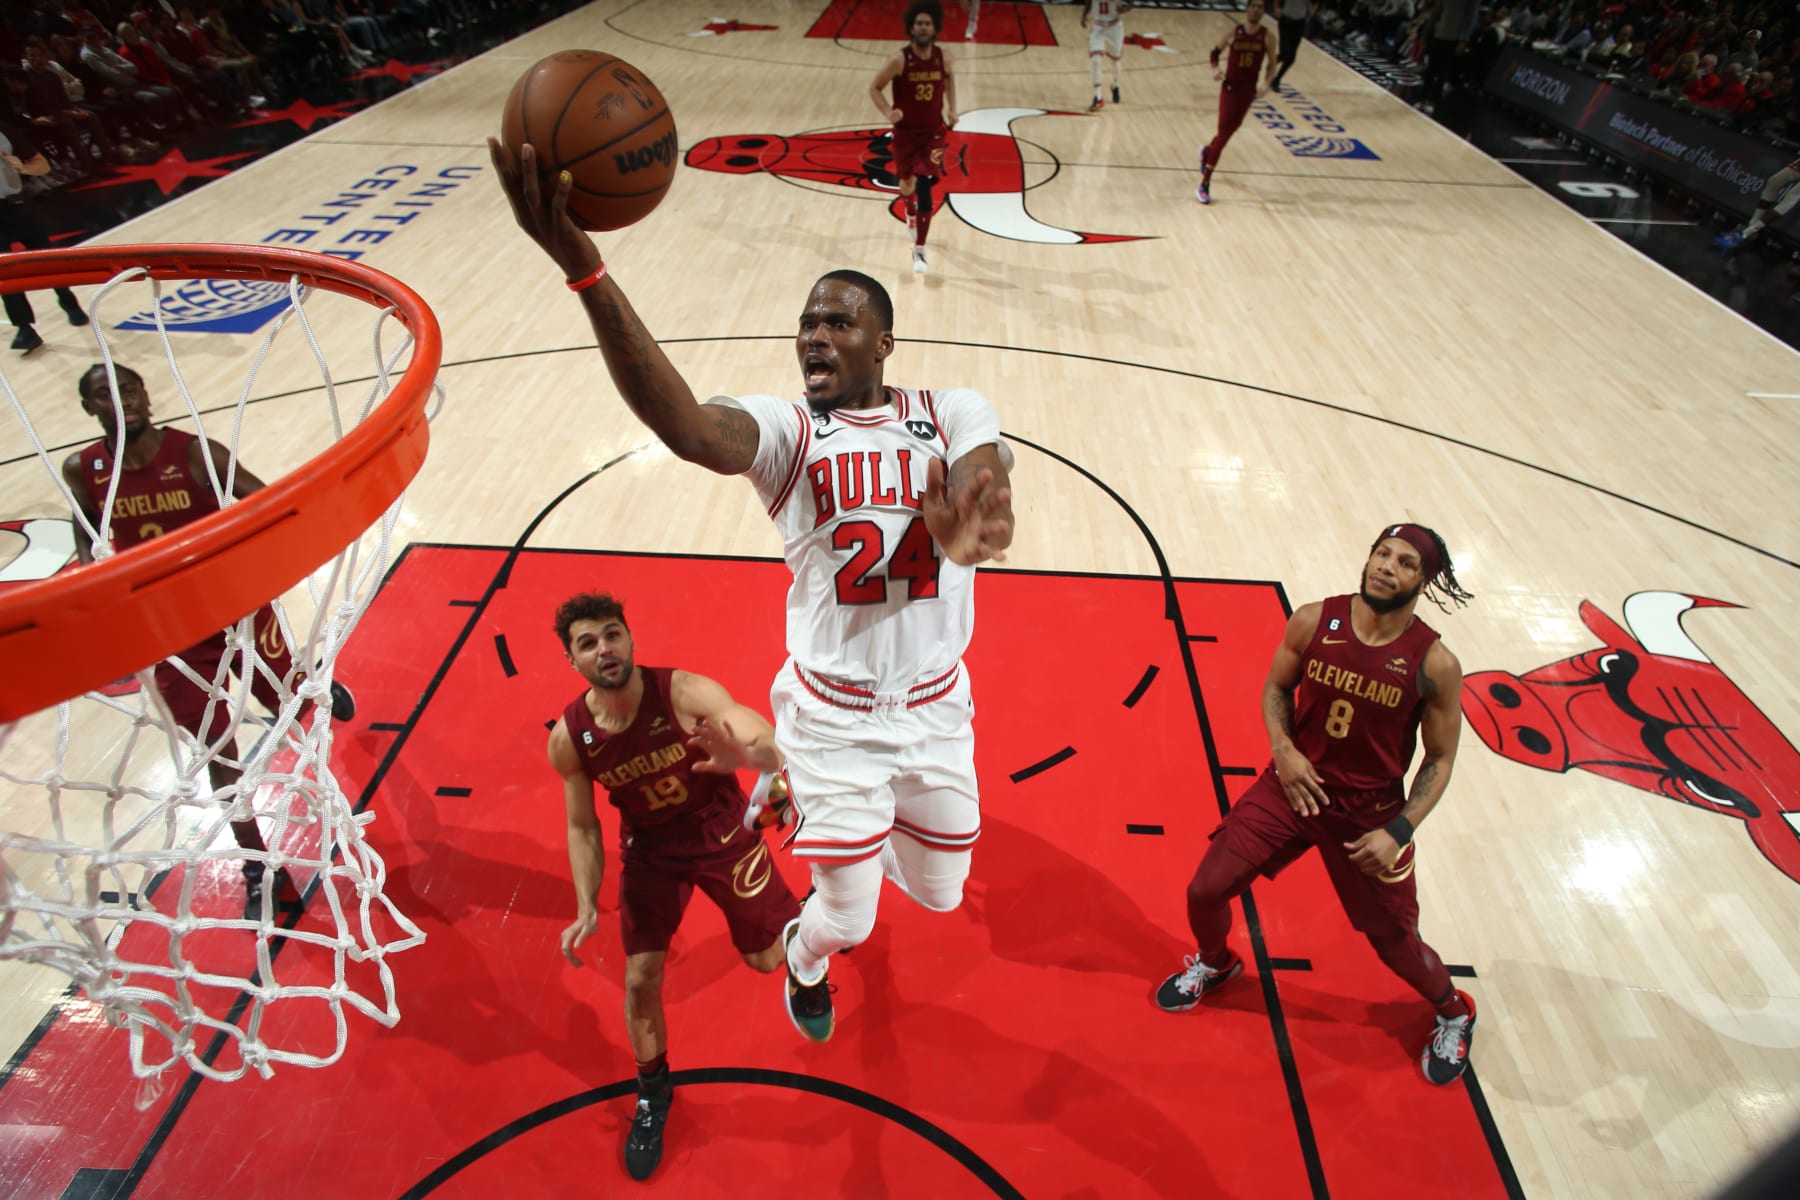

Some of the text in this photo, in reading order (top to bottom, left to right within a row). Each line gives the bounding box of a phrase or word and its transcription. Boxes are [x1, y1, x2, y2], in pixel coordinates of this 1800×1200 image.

[914, 83, 934, 101] 33
[1511, 64, 1571, 105] HORIZON
[1609, 112, 1648, 142] Biotech
[1644, 127, 1687, 158] Partner
[1684, 146, 1706, 163] of
[1697, 150, 1719, 172] the
[1717, 159, 1765, 194] Chicago
[262, 165, 418, 244] CENTE
[93, 458, 104, 471] 6
[807, 450, 947, 531] BULL
[832, 516, 940, 606] 24
[1329, 618, 1341, 631] 6
[1307, 658, 1402, 708] CLEVELAND
[582, 731, 593, 745] 6
[1325, 699, 1354, 739] 8
[598, 743, 687, 787] CLEVELAND
[640, 775, 688, 810] 19
